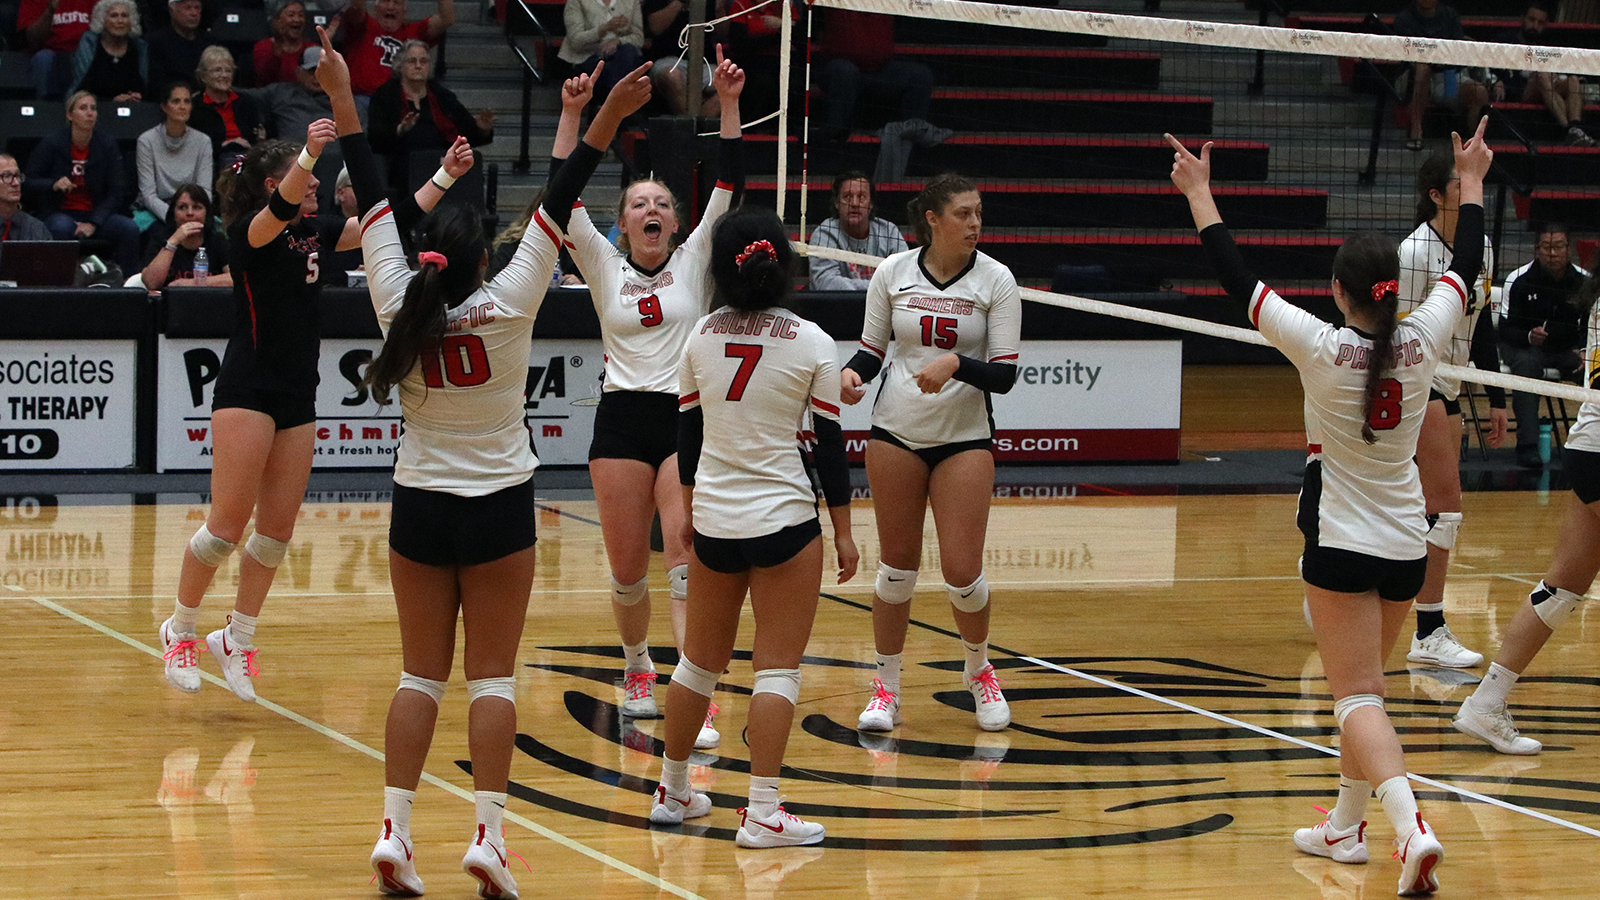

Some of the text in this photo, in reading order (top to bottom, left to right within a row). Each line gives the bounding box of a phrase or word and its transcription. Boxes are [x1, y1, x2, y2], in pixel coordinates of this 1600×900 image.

[305, 252, 320, 284] 5
[637, 293, 664, 328] 9
[700, 311, 801, 340] PACIFIC
[919, 315, 959, 350] 15
[724, 342, 764, 402] 7
[7, 396, 109, 420] THERAPY
[1369, 377, 1403, 430] 8
[339, 446, 372, 455] fresh
